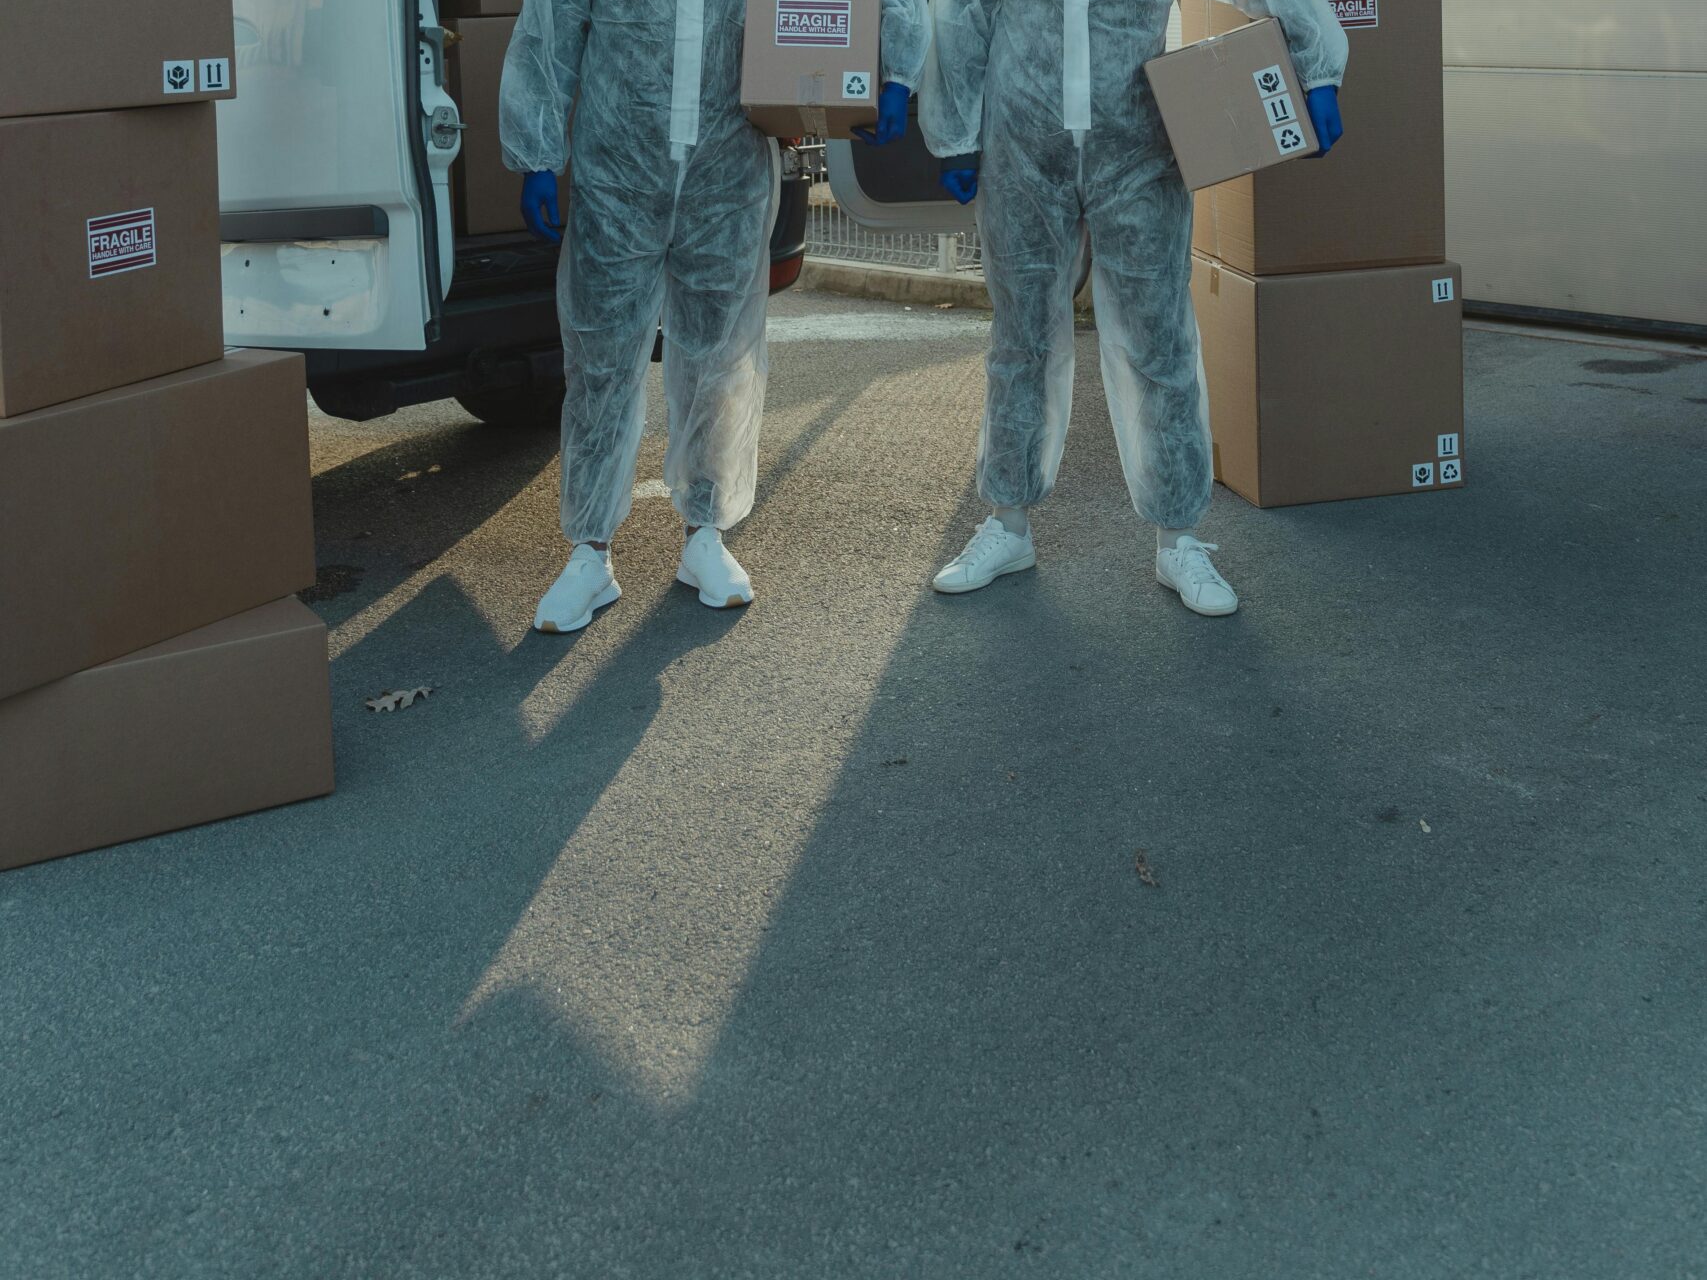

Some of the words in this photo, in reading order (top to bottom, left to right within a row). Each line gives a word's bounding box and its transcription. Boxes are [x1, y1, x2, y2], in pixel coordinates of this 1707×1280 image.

[1330, 0, 1374, 12] RAGILE
[779, 13, 847, 28] FRAGILE
[91, 226, 152, 253] FRAGILE
[92, 248, 118, 260] HANDLE
[118, 245, 134, 255] WITH
[134, 241, 152, 251] CARE
